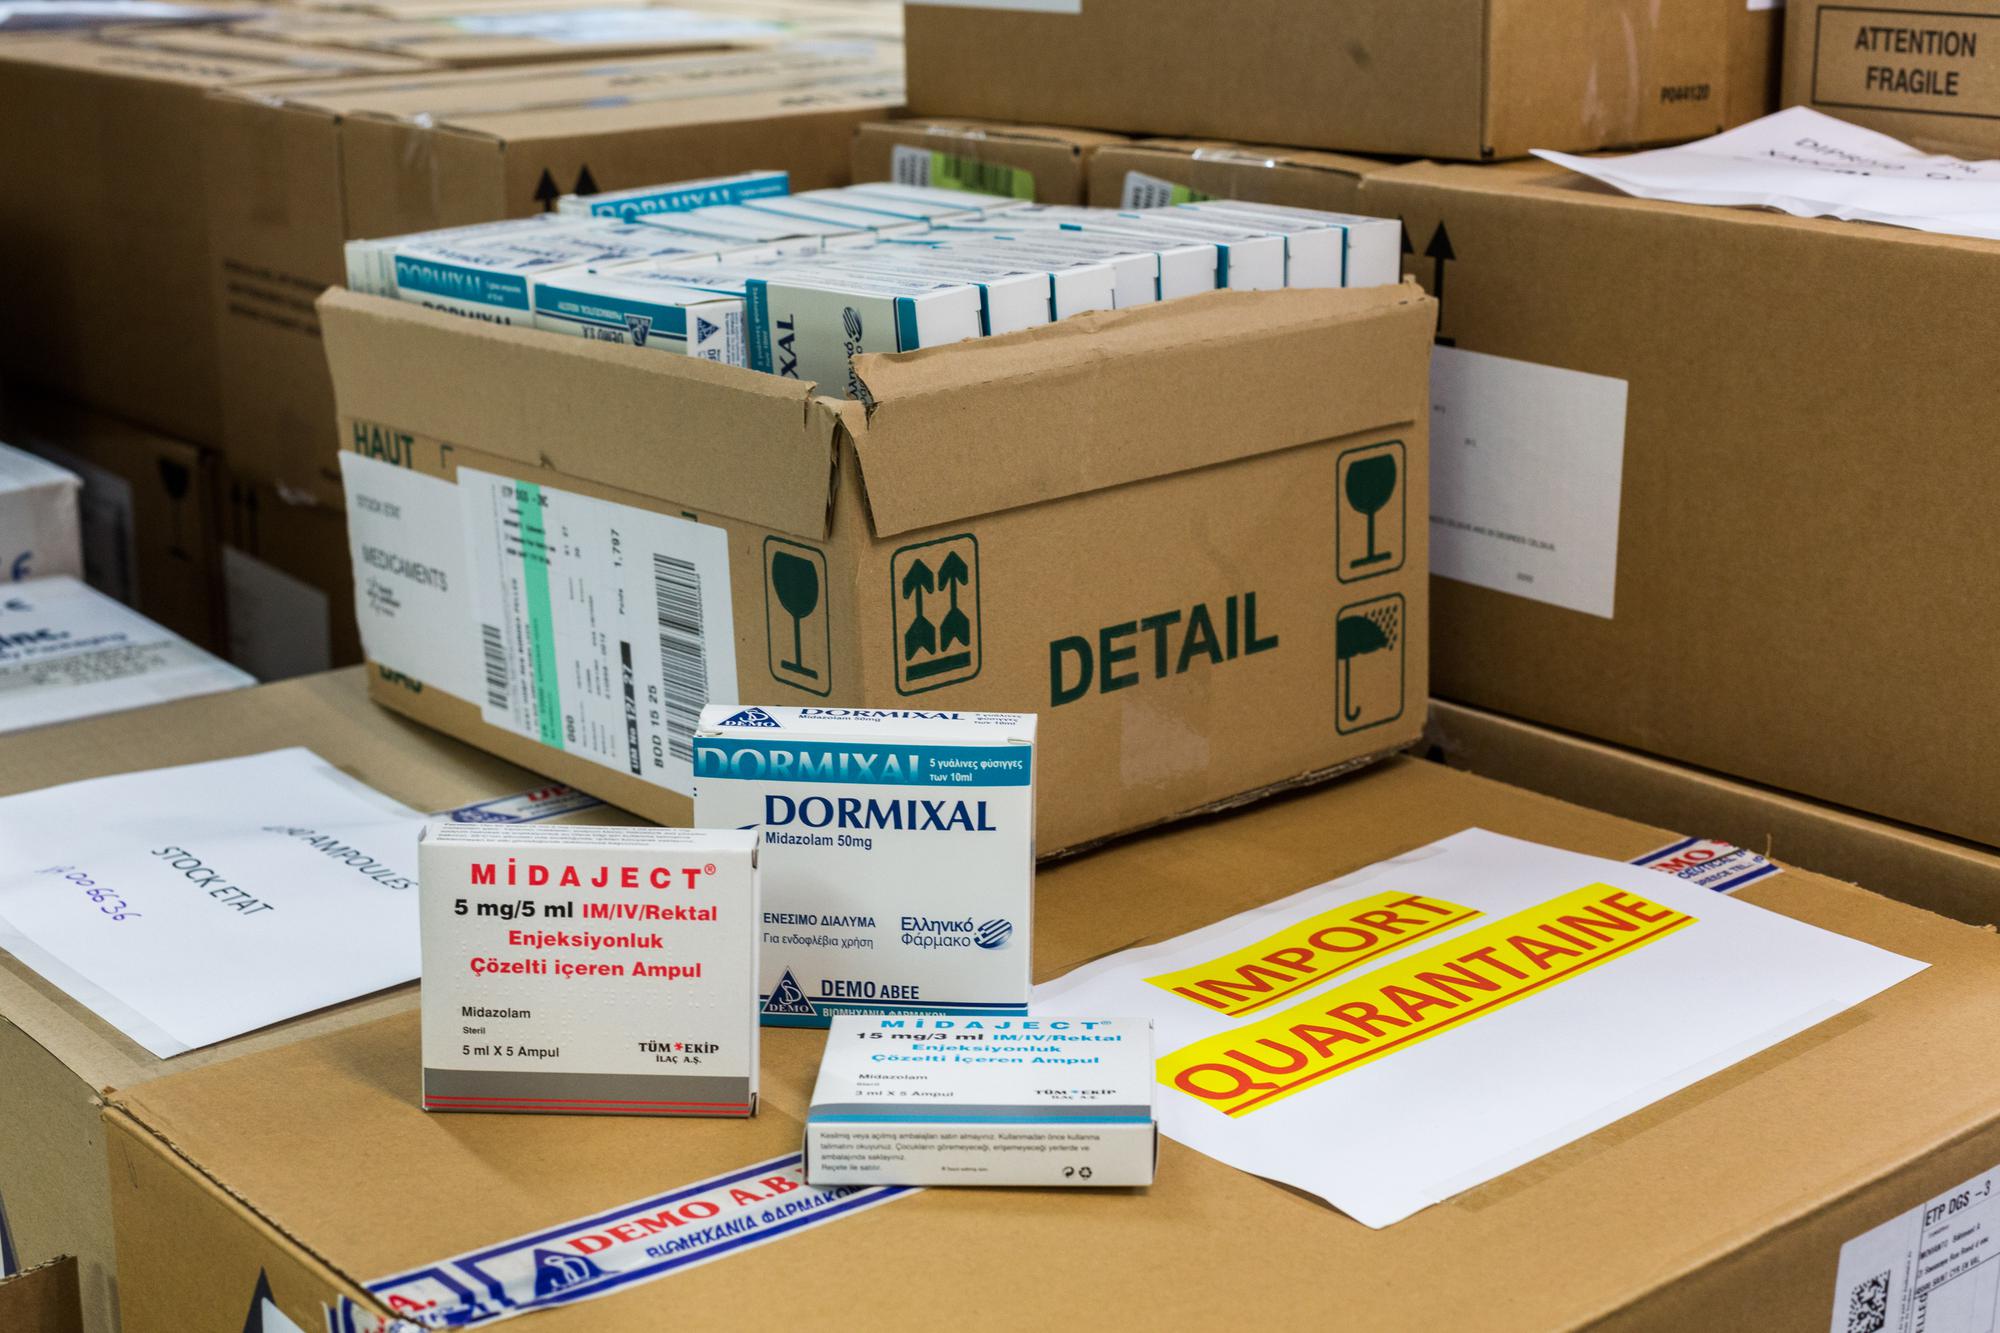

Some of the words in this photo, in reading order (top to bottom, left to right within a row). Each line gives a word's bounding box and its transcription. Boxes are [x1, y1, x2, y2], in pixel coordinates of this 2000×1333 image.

[1855, 26, 1976, 57] ATTENTION
[1866, 66, 1959, 96] FRAGILE
[353, 421, 414, 469] HAUT
[611, 528, 623, 568] 1.797
[362, 543, 448, 592] MEDICAMENTS
[1050, 591, 1279, 708] DETAIL
[648, 685, 658, 704] 25
[650, 709, 661, 727] 15
[801, 708, 966, 720] DORMIXAL
[930, 759, 936, 768] 5
[938, 760, 978, 771] γυάλινες
[980, 759, 1023, 771] φύσιγγες
[930, 774, 948, 782] των
[950, 773, 973, 782] 10ml
[765, 795, 996, 831] DORMIXAL
[765, 832, 833, 846] Midazolam
[838, 835, 872, 850] 50mg
[302, 835, 419, 890] AMPOULES
[1650, 848, 1715, 875] MO
[151, 846, 227, 888] STOCK
[210, 885, 274, 916] ETAT
[454, 899, 468, 916] 5
[476, 900, 535, 920] mg/5
[544, 901, 573, 918] ml
[582, 903, 717, 921] IM/IV/Rektal
[763, 913, 818, 925] ΕΝΕΣΙΜΟ
[820, 915, 876, 928] ΔΙΑΛΥΜΑ
[901, 917, 974, 936] Ελληνικό
[508, 930, 664, 950] Enjeksiyonluk
[763, 933, 779, 944] Για
[781, 934, 839, 947] ενδοφλέβια
[841, 938, 873, 949] χρήση
[901, 933, 971, 949] Φάρμακο
[1172, 895, 1453, 1010] IMPORT
[470, 957, 547, 977] Çözelti
[554, 959, 624, 980] içeren
[632, 962, 701, 980] Ampul
[821, 980, 876, 998] DEMO
[880, 985, 920, 1000] ABEE
[1174, 892, 1674, 1101] QUARANTAINE
[462, 1006, 531, 1019] Midazolam
[769, 1004, 809, 1012] DEMO
[463, 1026, 486, 1035] Steril
[857, 1032, 883, 1040] 15
[891, 1033, 947, 1041] mg/3
[993, 1034, 1121, 1042] IM/IV/Rektal
[463, 1045, 470, 1056] 5
[474, 1045, 490, 1056] ml
[493, 1046, 502, 1056] X
[506, 1046, 514, 1057] 5
[518, 1046, 559, 1058] Ampul
[638, 1041, 671, 1053] TÜM
[684, 1042, 719, 1054] EKİP
[912, 1043, 1062, 1053] Enjeksiyonluk
[871, 1054, 946, 1062] Çözelti
[1031, 1056, 1099, 1065] Ampul
[566, 1201, 721, 1255] DEMO
[728, 1167, 804, 1208] A.B
[1925, 1203, 1946, 1227] ETP
[1948, 1190, 1970, 1215] DGS
